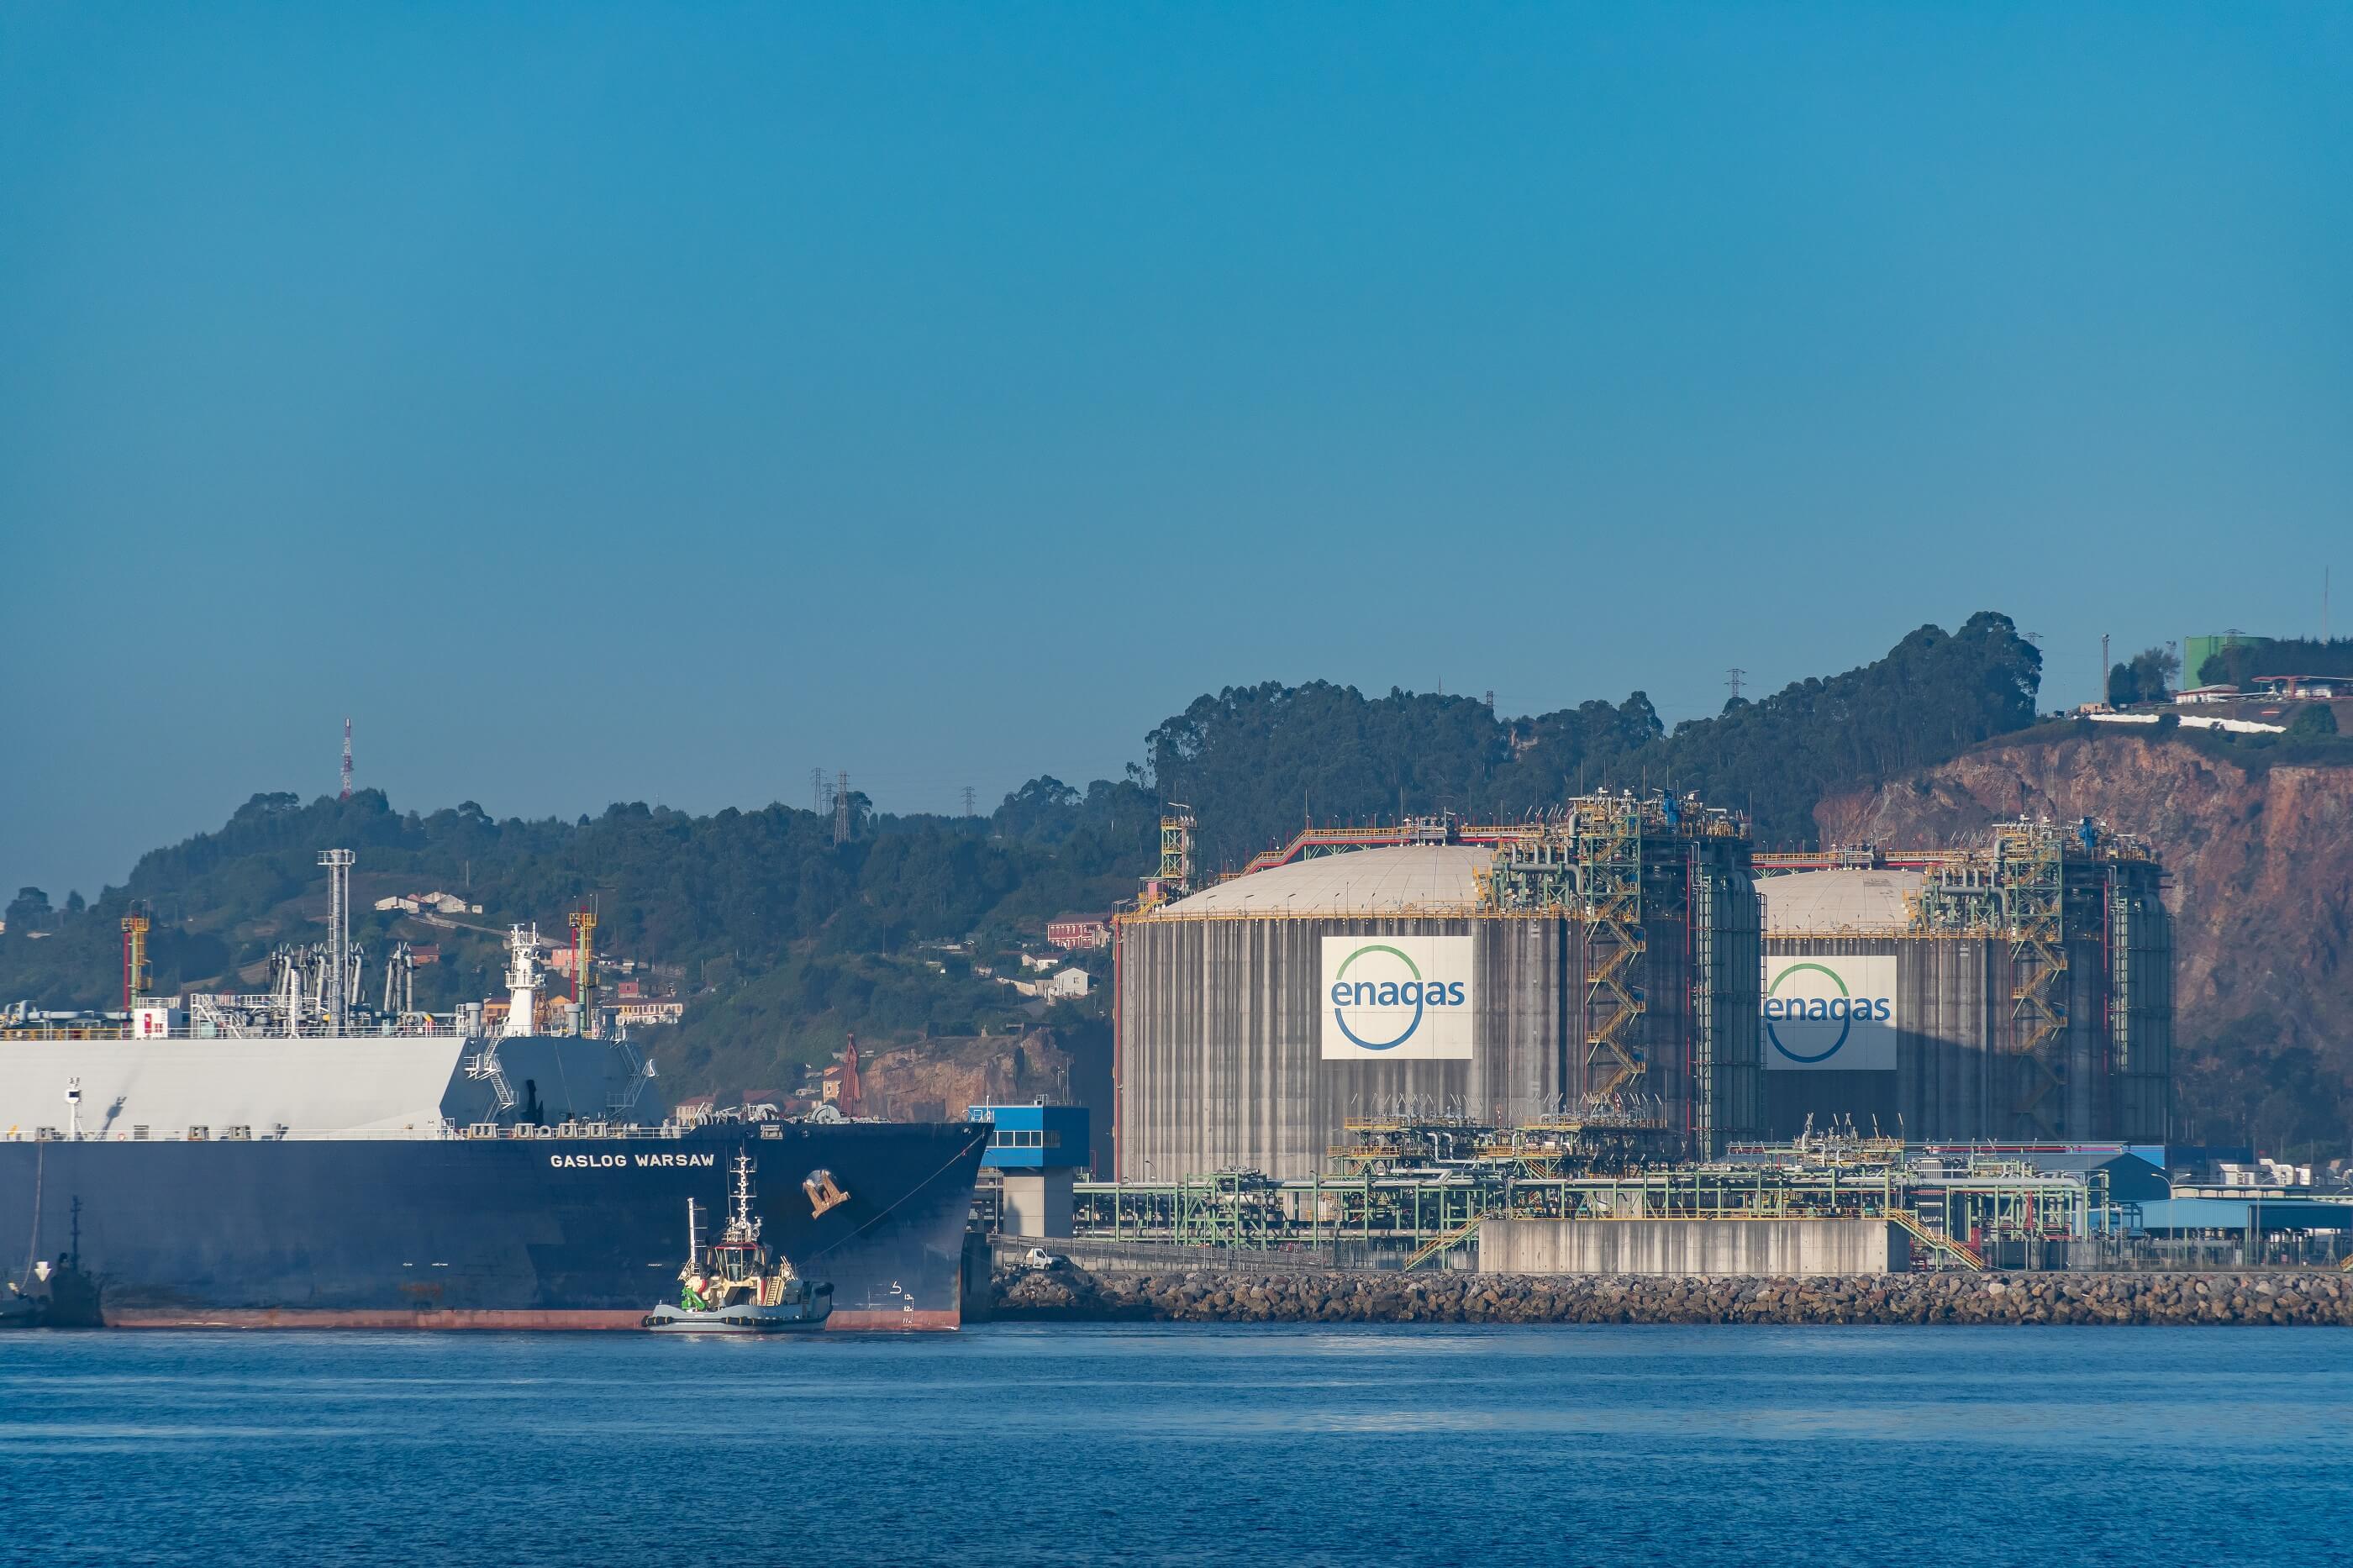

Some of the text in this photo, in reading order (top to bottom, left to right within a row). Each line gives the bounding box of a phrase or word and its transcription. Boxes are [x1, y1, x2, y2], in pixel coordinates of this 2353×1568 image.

[1331, 981, 1466, 1008] enagas
[1766, 997, 1891, 1023] enagas
[550, 1154, 714, 1168] GASLOG WARSAW
